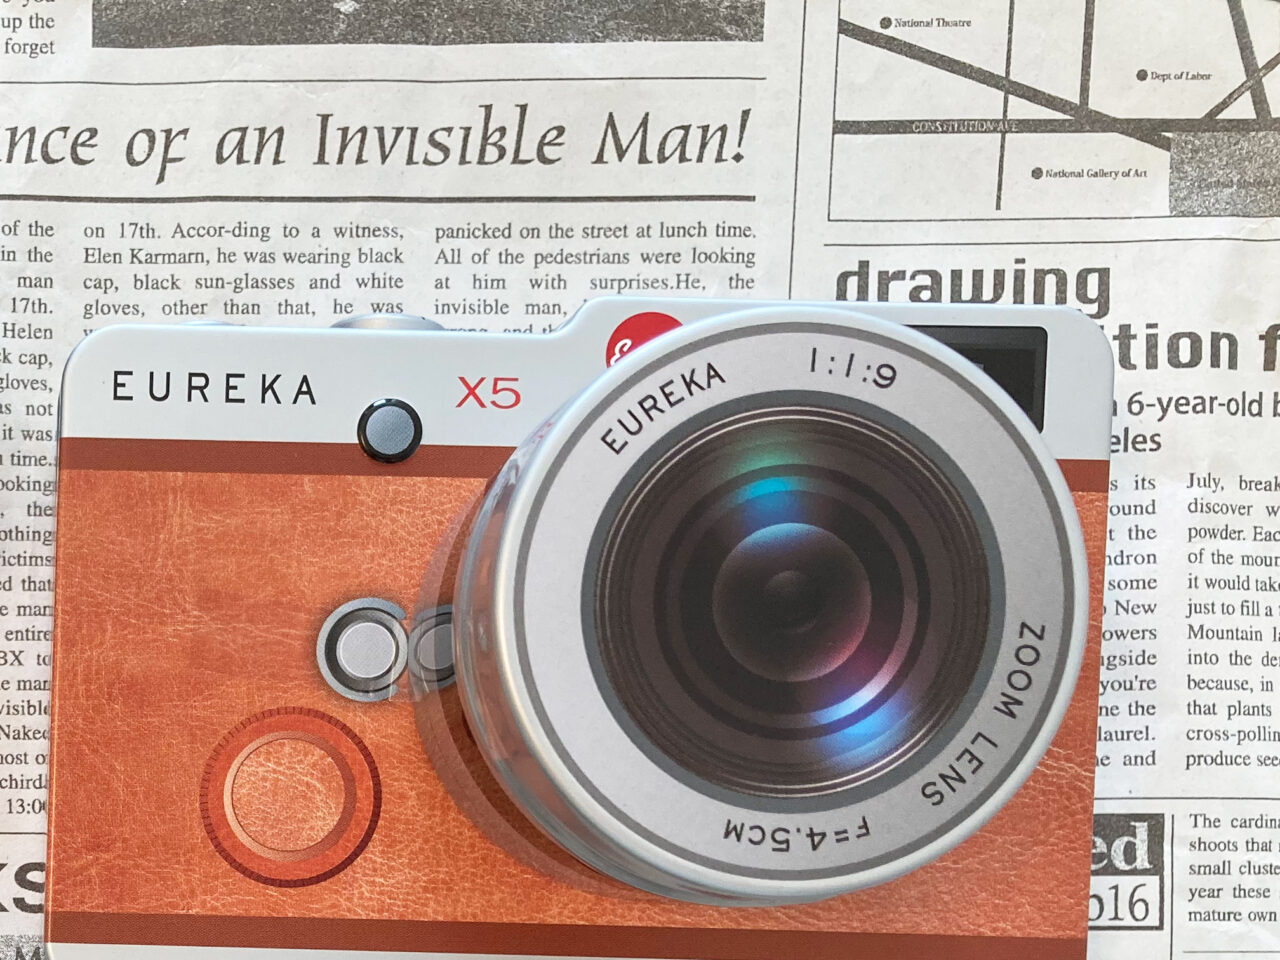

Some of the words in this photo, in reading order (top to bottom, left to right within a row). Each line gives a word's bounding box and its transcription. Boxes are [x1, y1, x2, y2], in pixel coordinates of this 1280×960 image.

[5, 38, 54, 58] forget
[126, 124, 187, 185] of
[215, 124, 286, 169] an
[591, 109, 748, 168] Man!
[84, 227, 104, 238] on
[120, 223, 160, 238] 17th.
[283, 225, 299, 238] to
[312, 227, 320, 238] a
[334, 222, 403, 239] witness,
[435, 248, 461, 264] All
[472, 248, 490, 264] of
[499, 248, 524, 264] the
[534, 248, 629, 268] pedestrians
[641, 252, 681, 264] were
[692, 247, 755, 268] looking
[112, 370, 317, 406] EUREKA
[455, 376, 520, 409] X5
[600, 362, 726, 454] EUREKA
[1127, 390, 1263, 423] 6-year-old
[993, 621, 1046, 720] ZOOM
[921, 731, 999, 806] LENS
